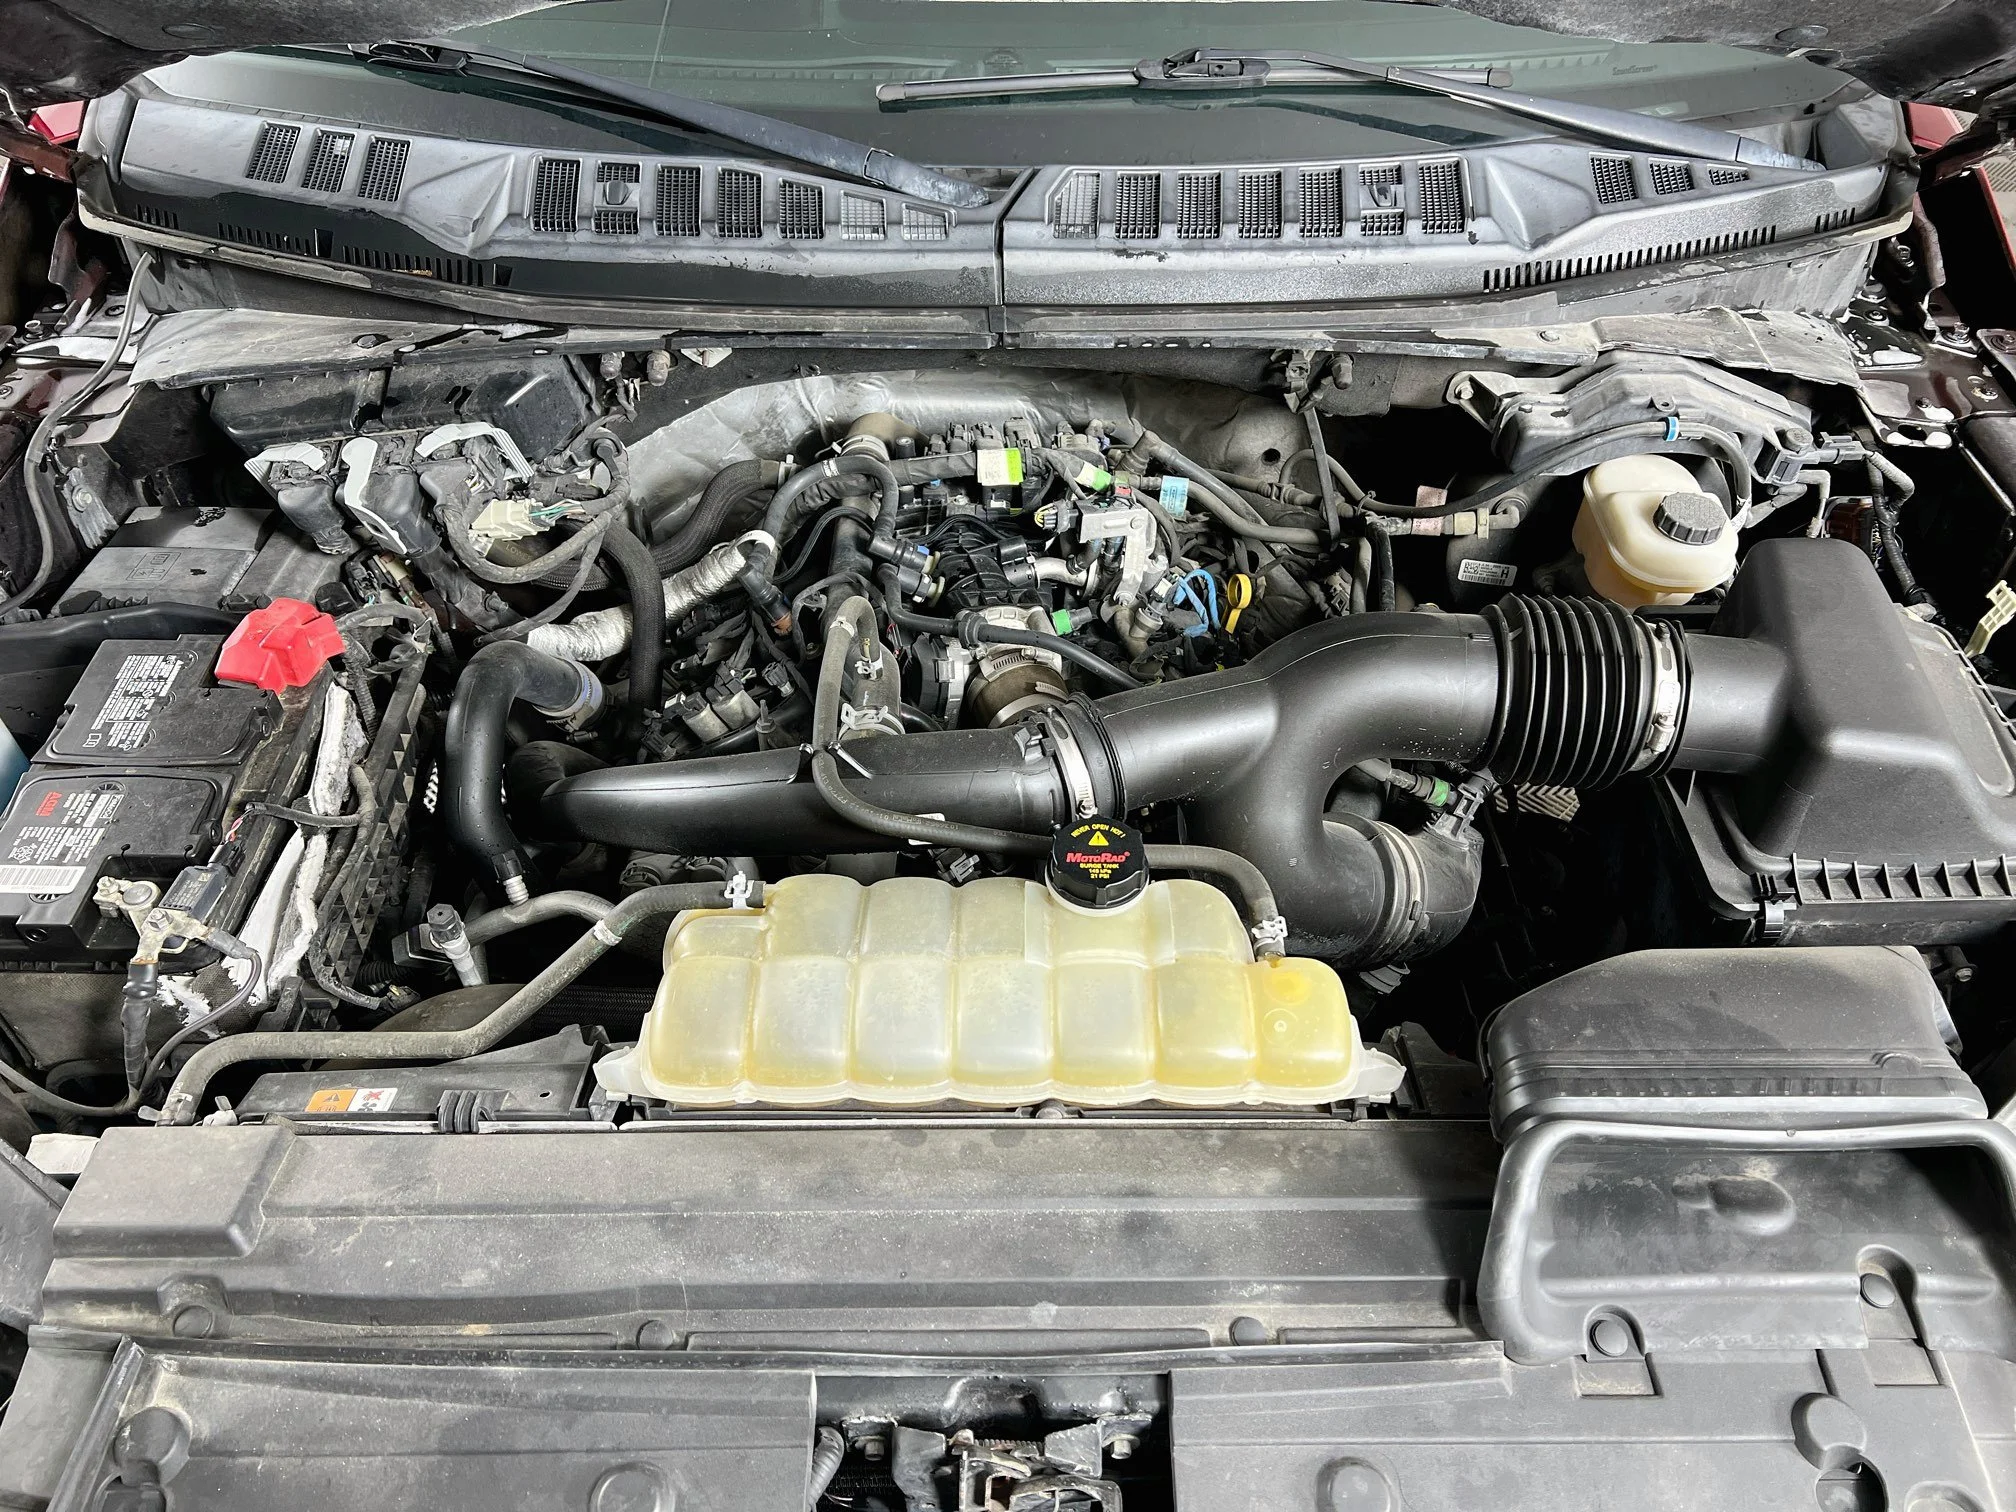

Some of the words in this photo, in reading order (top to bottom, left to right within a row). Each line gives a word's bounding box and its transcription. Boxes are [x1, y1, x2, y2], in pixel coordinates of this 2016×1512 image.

[1501, 569, 1510, 579] H
[39, 792, 63, 816] AGM
[1070, 825, 1090, 838] NEVER
[1091, 823, 1110, 831] OPEN
